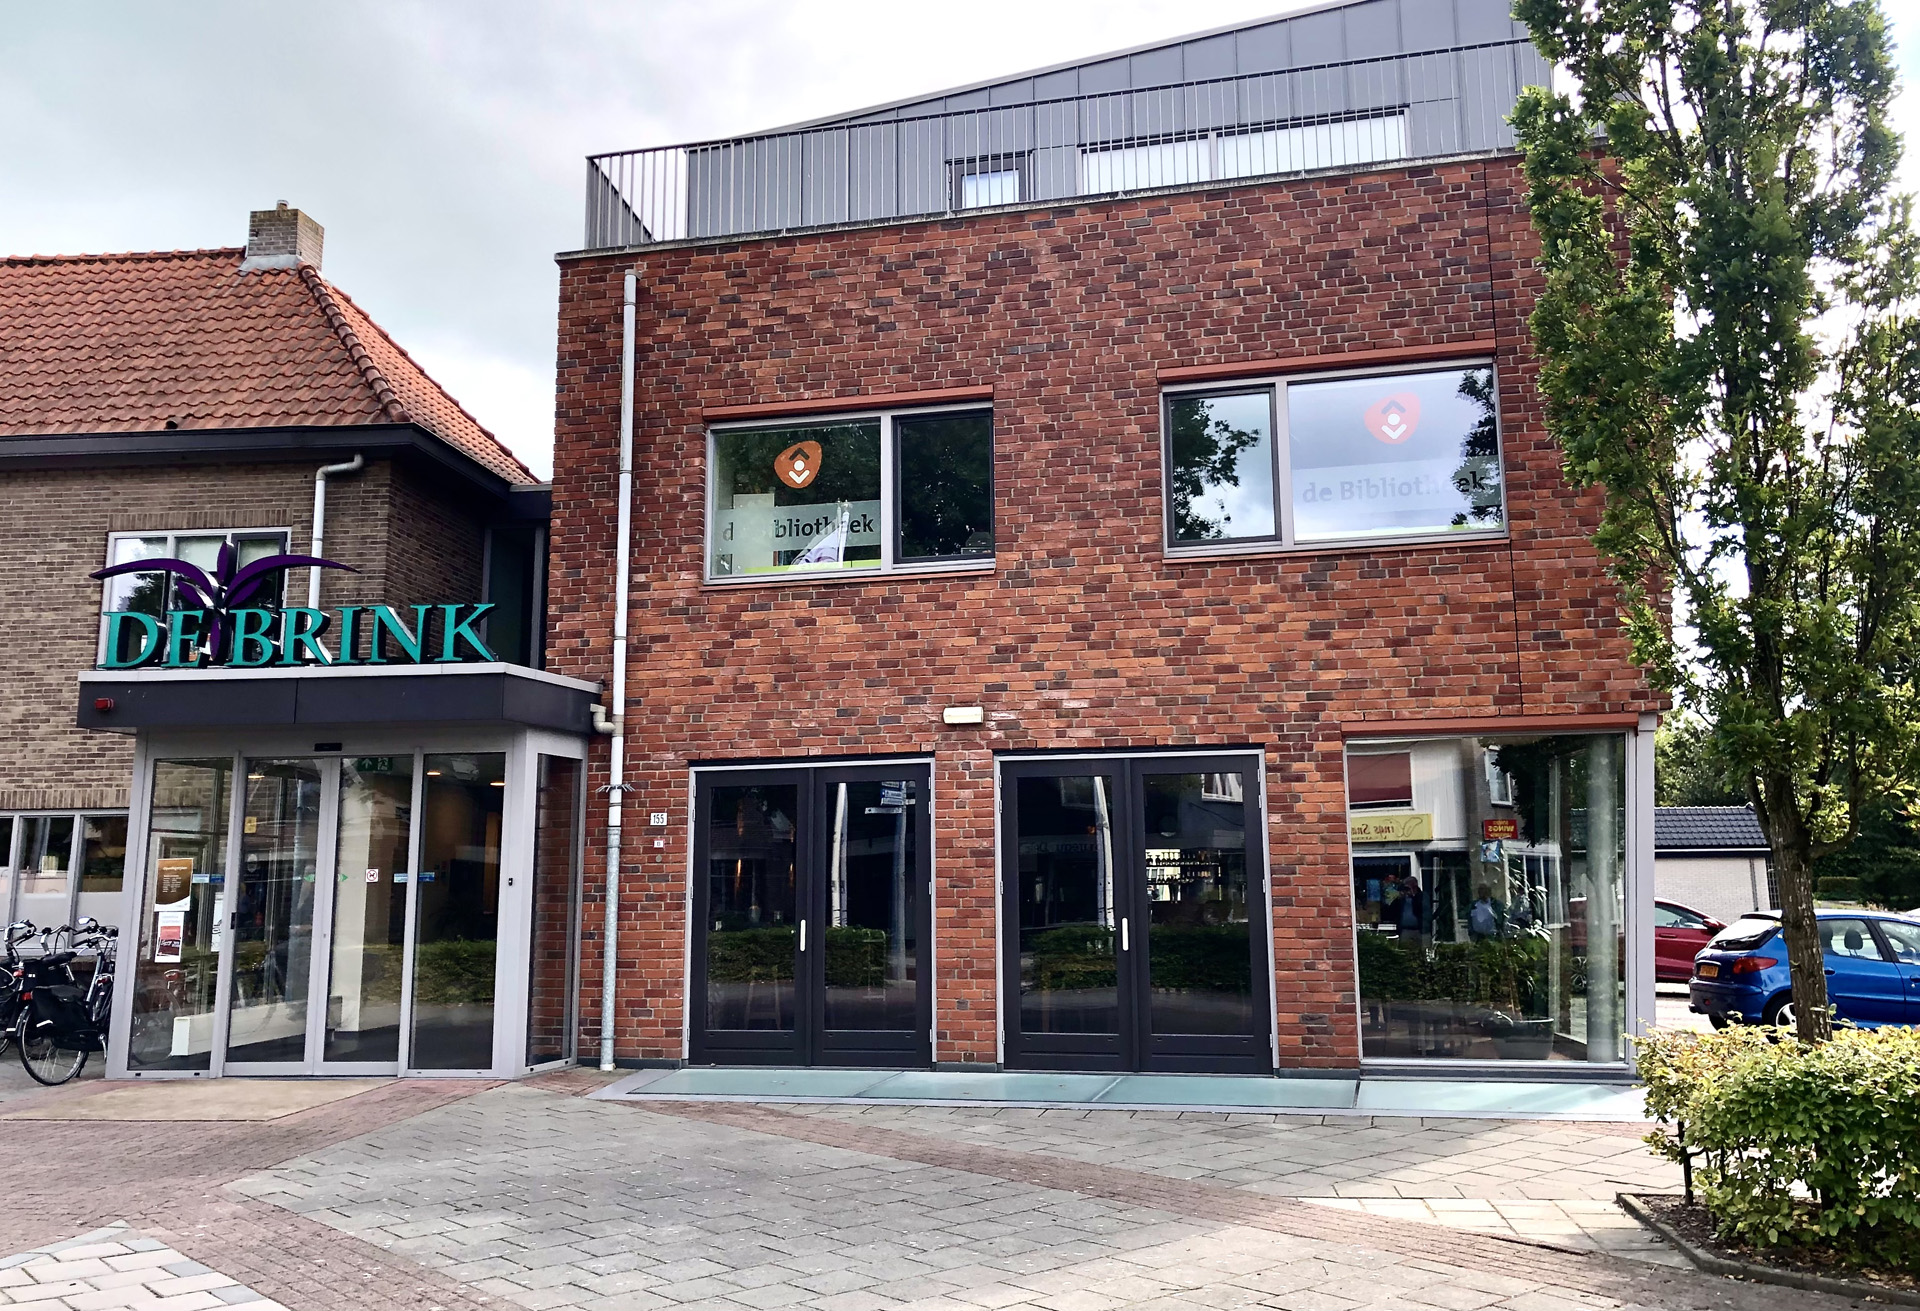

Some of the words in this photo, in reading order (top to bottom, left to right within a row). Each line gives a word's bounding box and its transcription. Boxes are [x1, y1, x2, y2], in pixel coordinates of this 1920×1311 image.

[1302, 481, 1333, 503] de
[97, 609, 206, 669] DE
[223, 602, 496, 668] BRINK
[653, 814, 664, 824] 155
